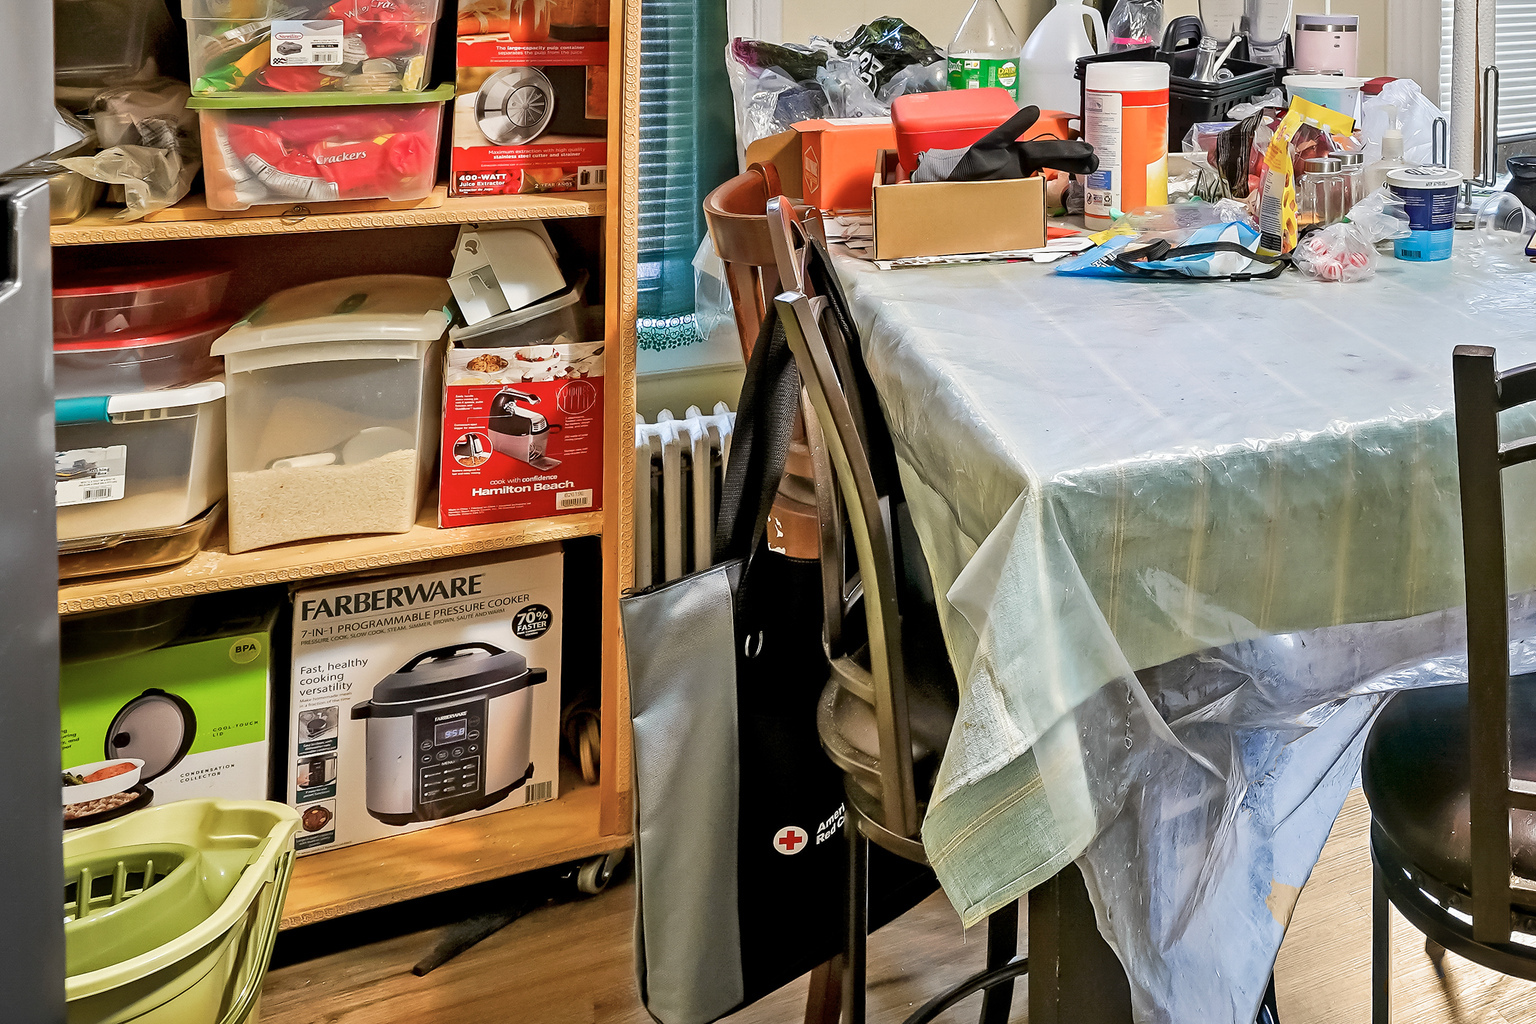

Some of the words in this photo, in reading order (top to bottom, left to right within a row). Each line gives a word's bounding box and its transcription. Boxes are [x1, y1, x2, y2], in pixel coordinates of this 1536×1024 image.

[316, 149, 367, 165] Crackers
[459, 173, 507, 181] 400-WATT
[490, 478, 506, 486] cook
[522, 474, 558, 483] confidence
[472, 484, 531, 497] Hamilton
[533, 480, 574, 492] Beach
[301, 574, 483, 621] FARBERWARE
[301, 625, 334, 638] 7-IN-1
[338, 612, 430, 634] PROGRAMMABLE
[434, 602, 485, 619] PRESSURE
[488, 593, 530, 608] COOKER
[517, 610, 548, 626] 70%
[300, 637, 329, 646] PRESSURE
[350, 631, 367, 639] SLOW
[475, 611, 487, 619] AND
[488, 608, 506, 617] WARM
[517, 621, 547, 632] FASTER
[235, 643, 256, 654] BPA
[300, 665, 325, 675] Fast,
[328, 659, 368, 671] healthy
[300, 673, 344, 686] cooking
[300, 682, 353, 696] versatility
[435, 711, 468, 722] FARBERWARE
[213, 720, 259, 732] COOL-TOUCH
[180, 763, 235, 778] CONDENSATION
[180, 772, 221, 783] COLLECTOR
[816, 802, 845, 834] Ameri
[816, 822, 836, 845] Red
